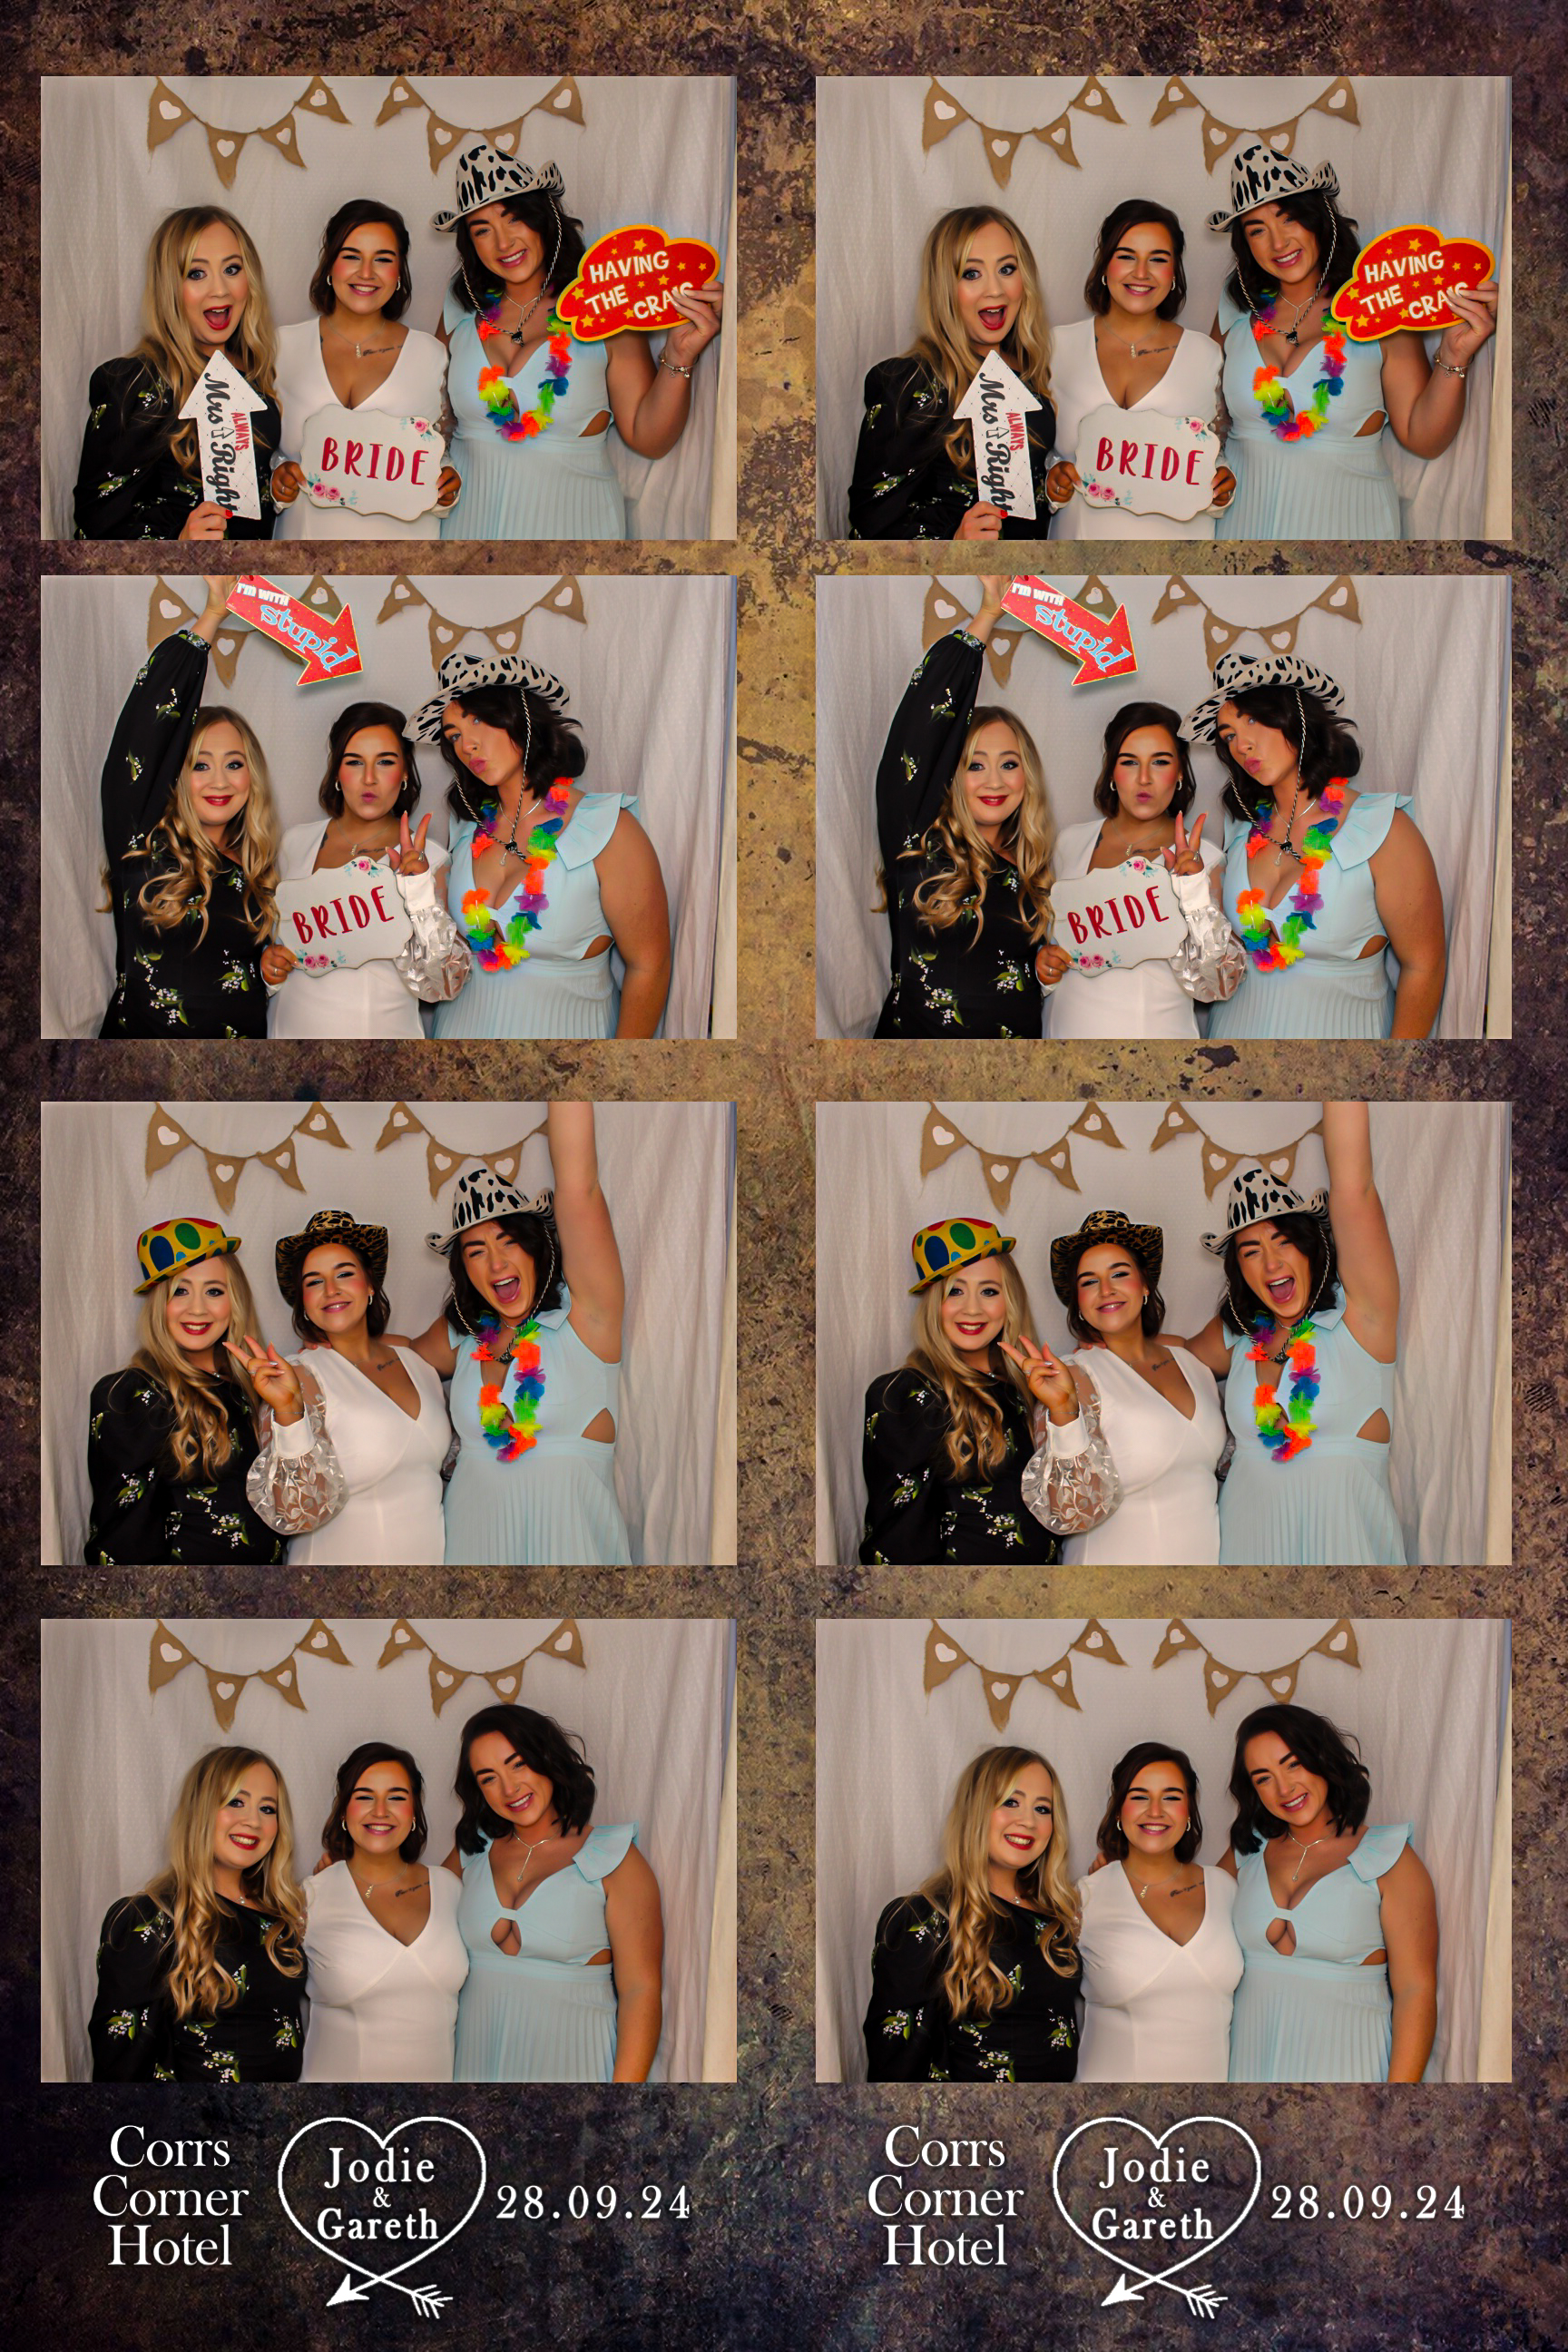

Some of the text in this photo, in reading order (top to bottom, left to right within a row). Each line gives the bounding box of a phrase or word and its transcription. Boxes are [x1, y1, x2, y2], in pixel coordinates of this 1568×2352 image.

[589, 250, 670, 284] HAVING
[1364, 250, 1445, 284] HAVING
[584, 284, 629, 315] THE
[1359, 284, 1404, 315] THE
[204, 372, 240, 513] Mrs Right
[230, 412, 250, 451] ALWAYS
[979, 372, 1015, 513] Mrs Right
[1005, 412, 1024, 451] ALWAYS
[321, 436, 429, 485] BRIDE
[1096, 436, 1204, 485] BRIDE
[258, 589, 290, 606] WITH
[1033, 589, 1065, 606] WITH
[260, 604, 358, 672] stupid
[1035, 604, 1132, 672] stupid
[292, 886, 395, 944] BRIDE
[1067, 886, 1170, 944] BRIDE
